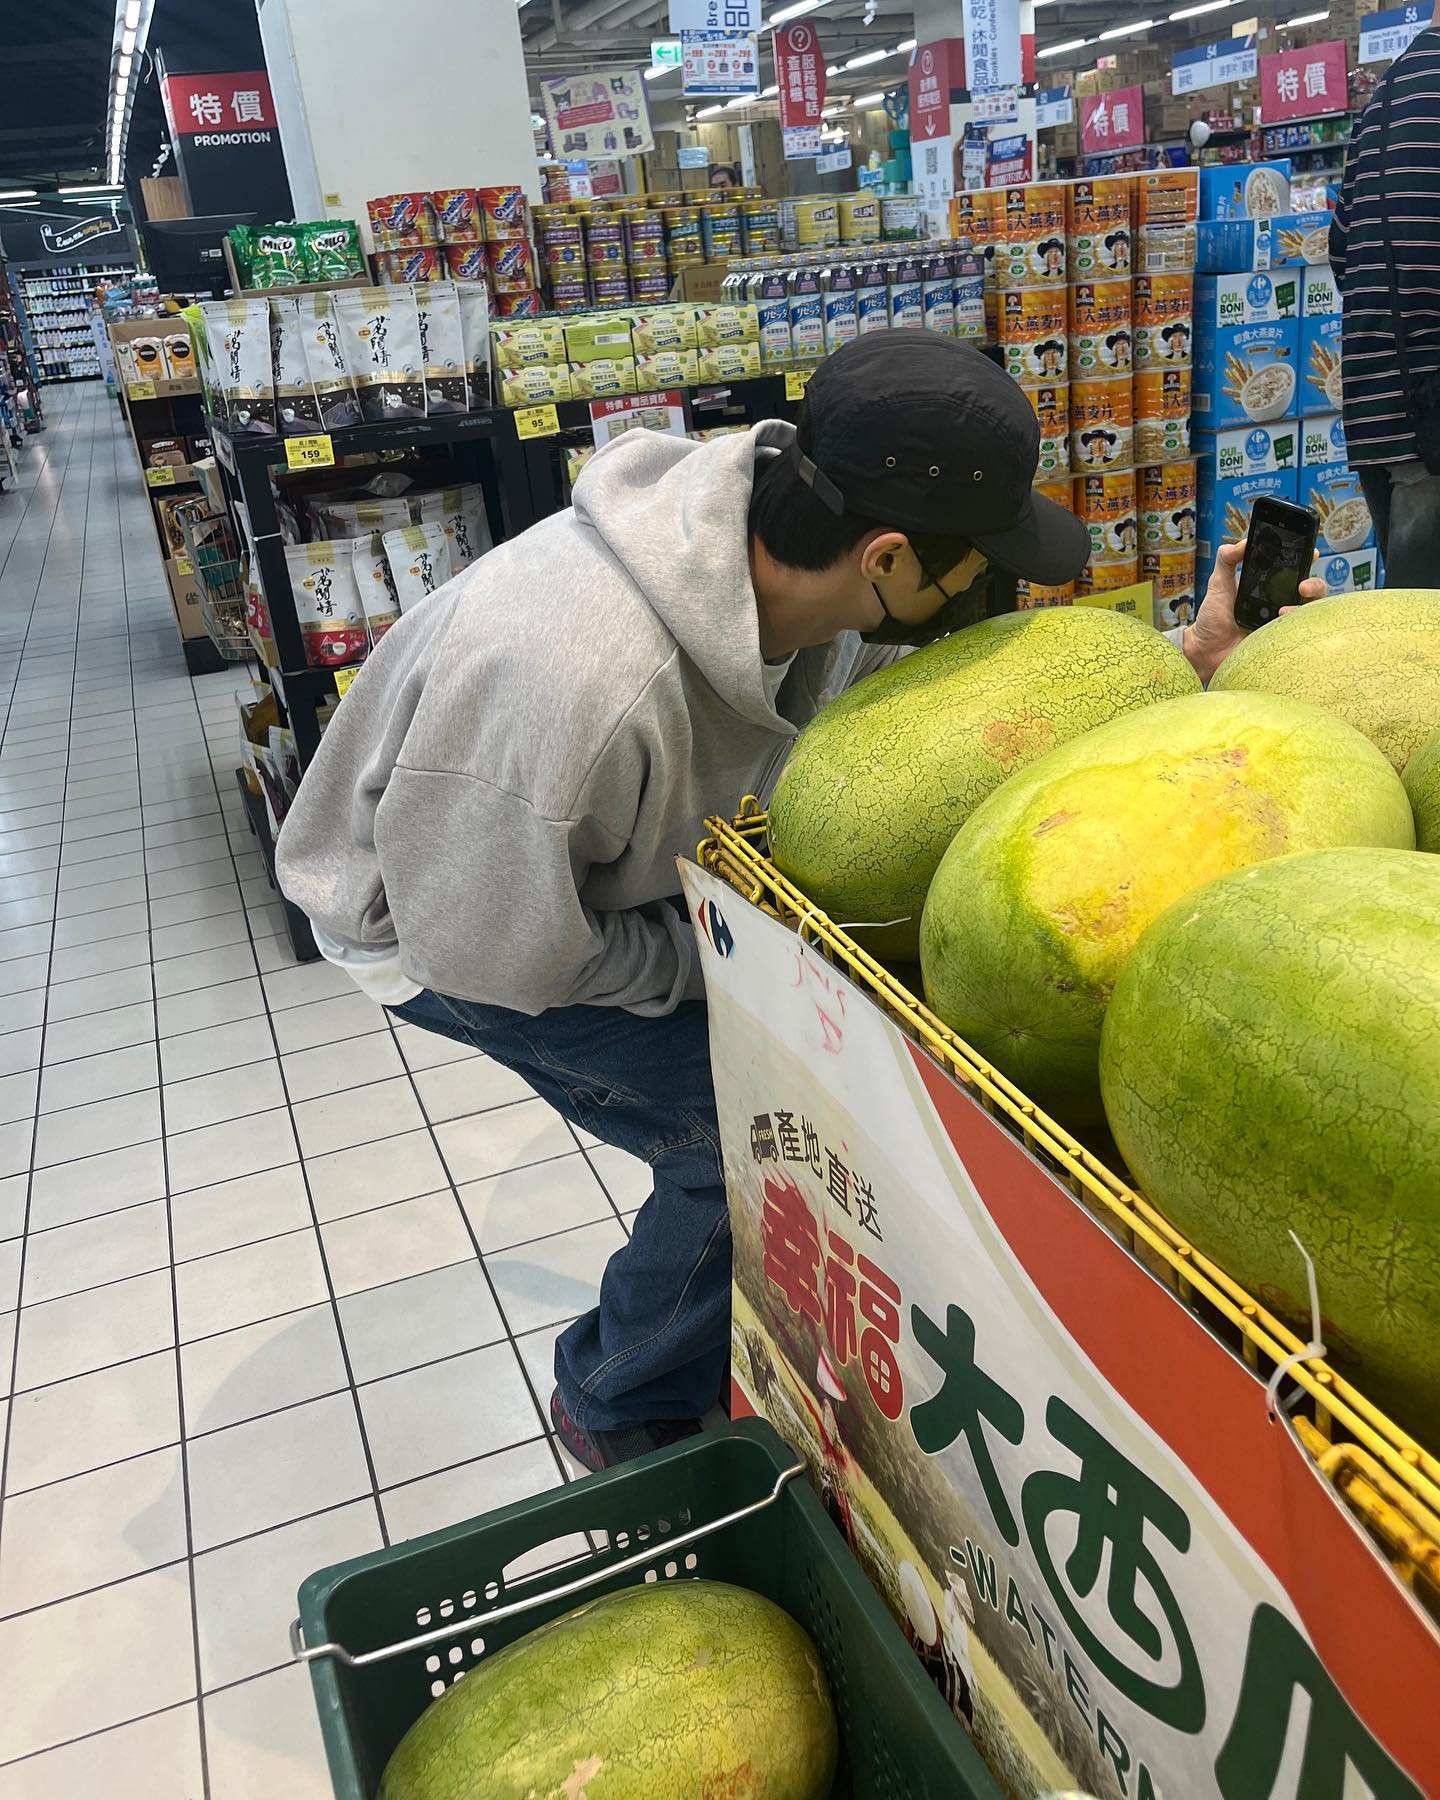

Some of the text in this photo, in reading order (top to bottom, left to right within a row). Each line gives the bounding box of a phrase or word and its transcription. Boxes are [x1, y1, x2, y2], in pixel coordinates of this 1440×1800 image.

[1404, 6, 1418, 23] 56
[1276, 61, 1328, 103] 特價
[189, 90, 265, 125] 特價
[1092, 103, 1130, 137] 特價
[194, 131, 272, 147] PROMOTION
[262, 239, 292, 250] MILO
[317, 234, 345, 248] MILO
[1308, 282, 1328, 293] OUI
[1220, 292, 1238, 303] OUI
[1308, 291, 1333, 304] BON!
[797, 305, 820, 319] リセッタ
[1141, 297, 1189, 314] 大燕麥片
[1220, 302, 1244, 314] BON!
[763, 309, 787, 322] リセッタ
[1012, 313, 1063, 331] 大燕麥片
[1233, 327, 1285, 345] 即食大燕麥片
[1071, 403, 1114, 420] 燕麥片
[531, 420, 544, 428] 95
[1306, 433, 1322, 445] OUI
[301, 449, 320, 459] 159
[1220, 446, 1237, 458] OUI
[1305, 442, 1328, 454] BON!
[1220, 455, 1244, 467] BON!
[1232, 478, 1283, 496] 即食大燕麥片
[757, 1127, 773, 1141] FRESH
[774, 1108, 884, 1243] 產地直送
[761, 1177, 905, 1422] 幸福
